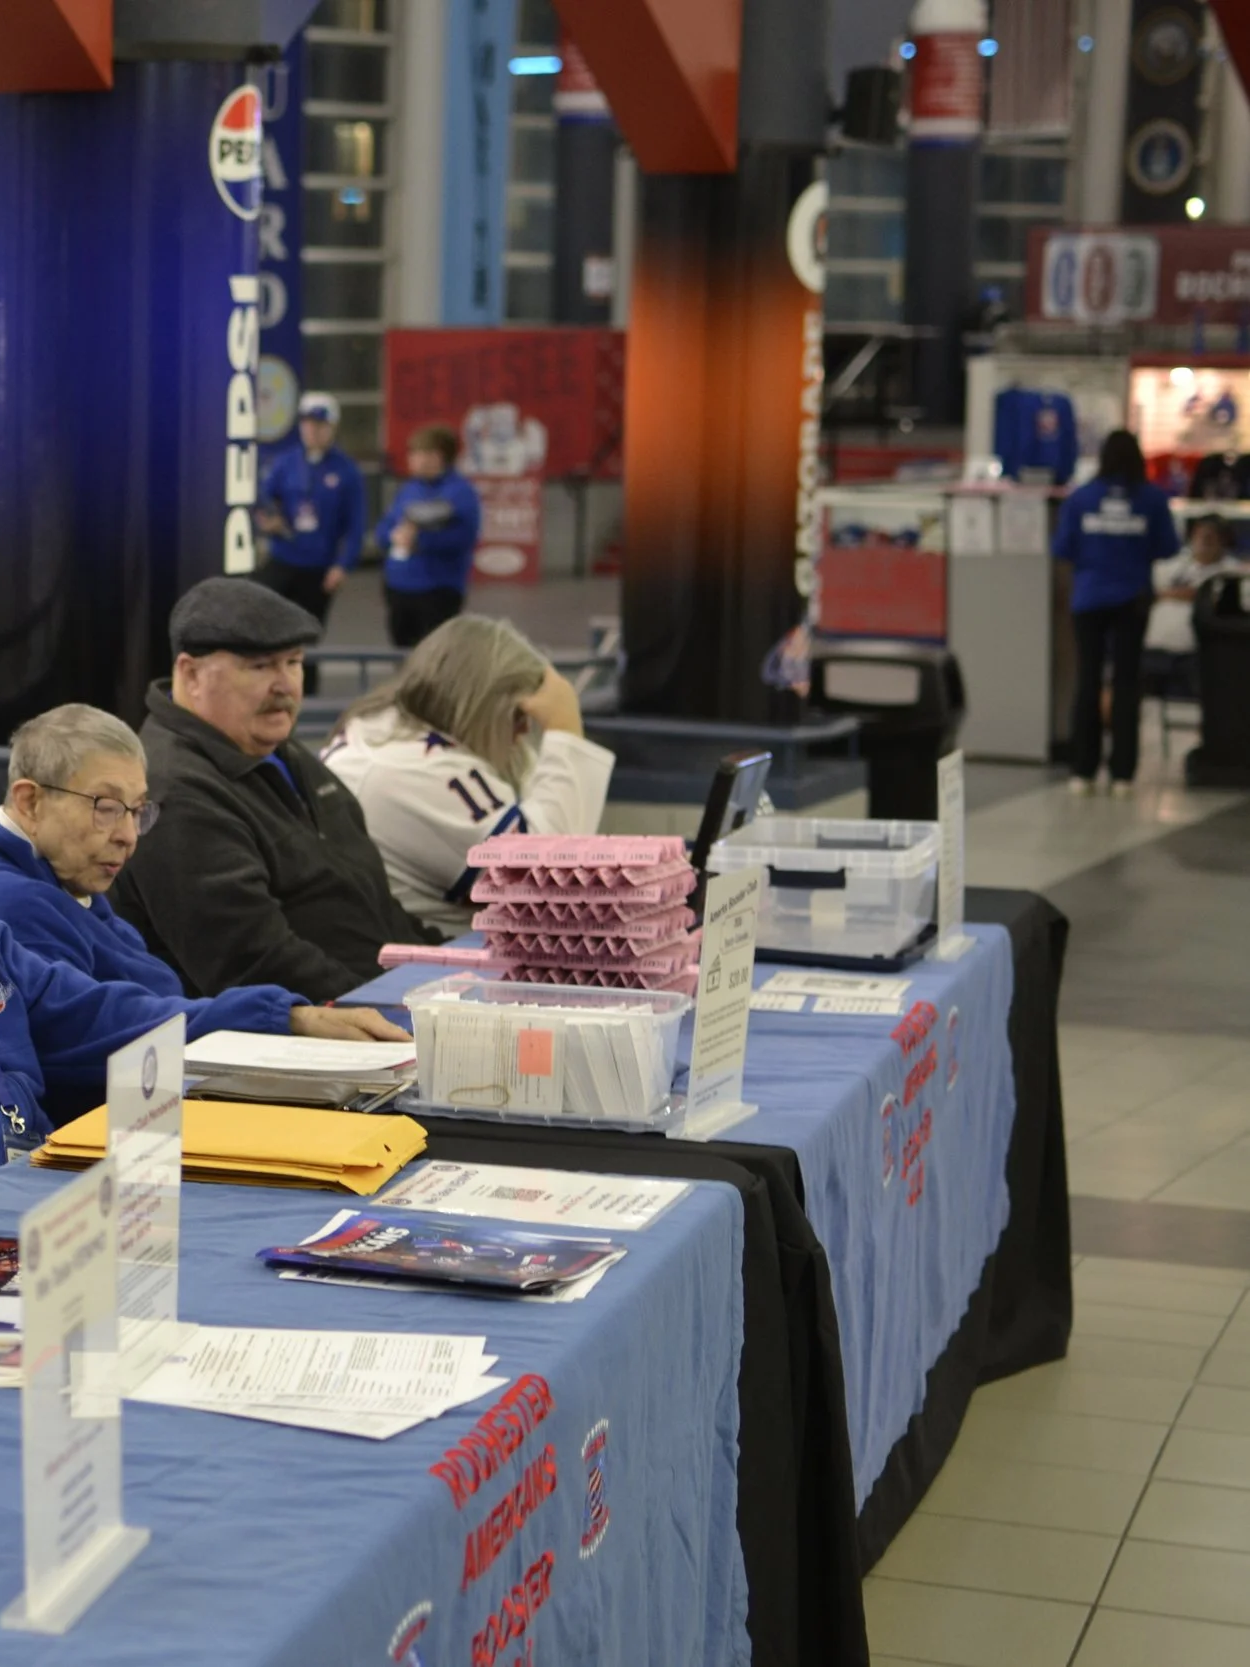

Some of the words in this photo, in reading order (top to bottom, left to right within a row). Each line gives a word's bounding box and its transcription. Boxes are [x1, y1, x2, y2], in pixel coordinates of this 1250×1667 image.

[224, 275, 260, 575] PEPSI
[448, 768, 505, 823] 11
[429, 1373, 556, 1512] ROCHESTER
[461, 1443, 557, 1595] AMERICANS
[472, 1551, 555, 1667] BOOSTER
